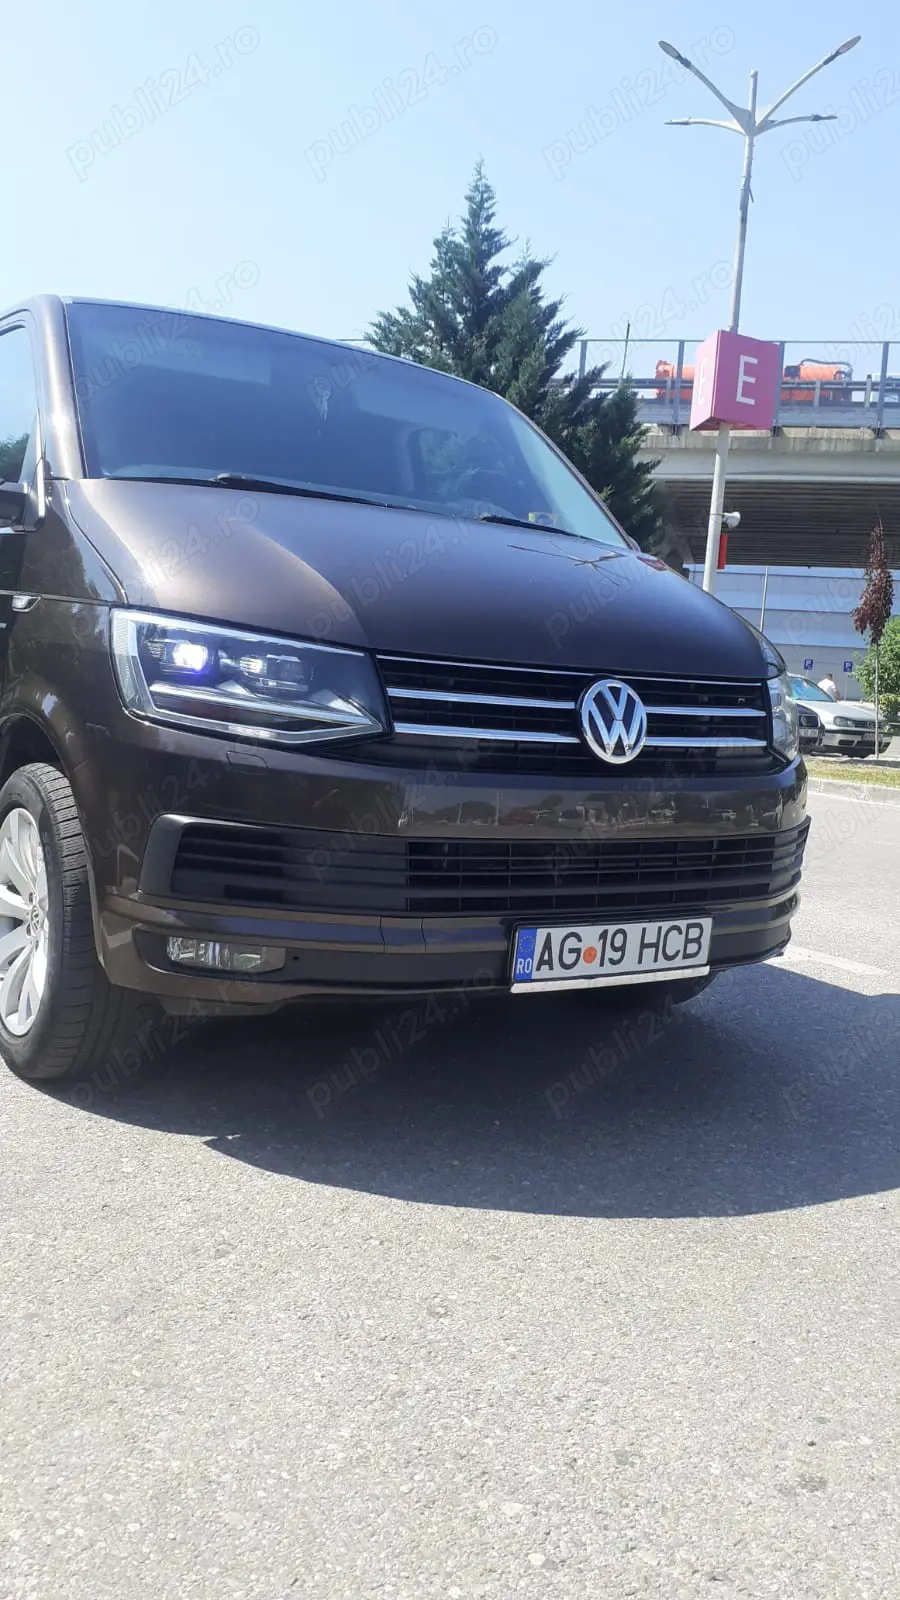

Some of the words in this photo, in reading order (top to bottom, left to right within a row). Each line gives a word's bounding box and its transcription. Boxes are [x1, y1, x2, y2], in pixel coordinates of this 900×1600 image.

[736, 354, 758, 405] E
[516, 958, 533, 974] RO
[535, 931, 583, 971] AG
[597, 928, 628, 967] 19
[638, 922, 704, 964] HCB
